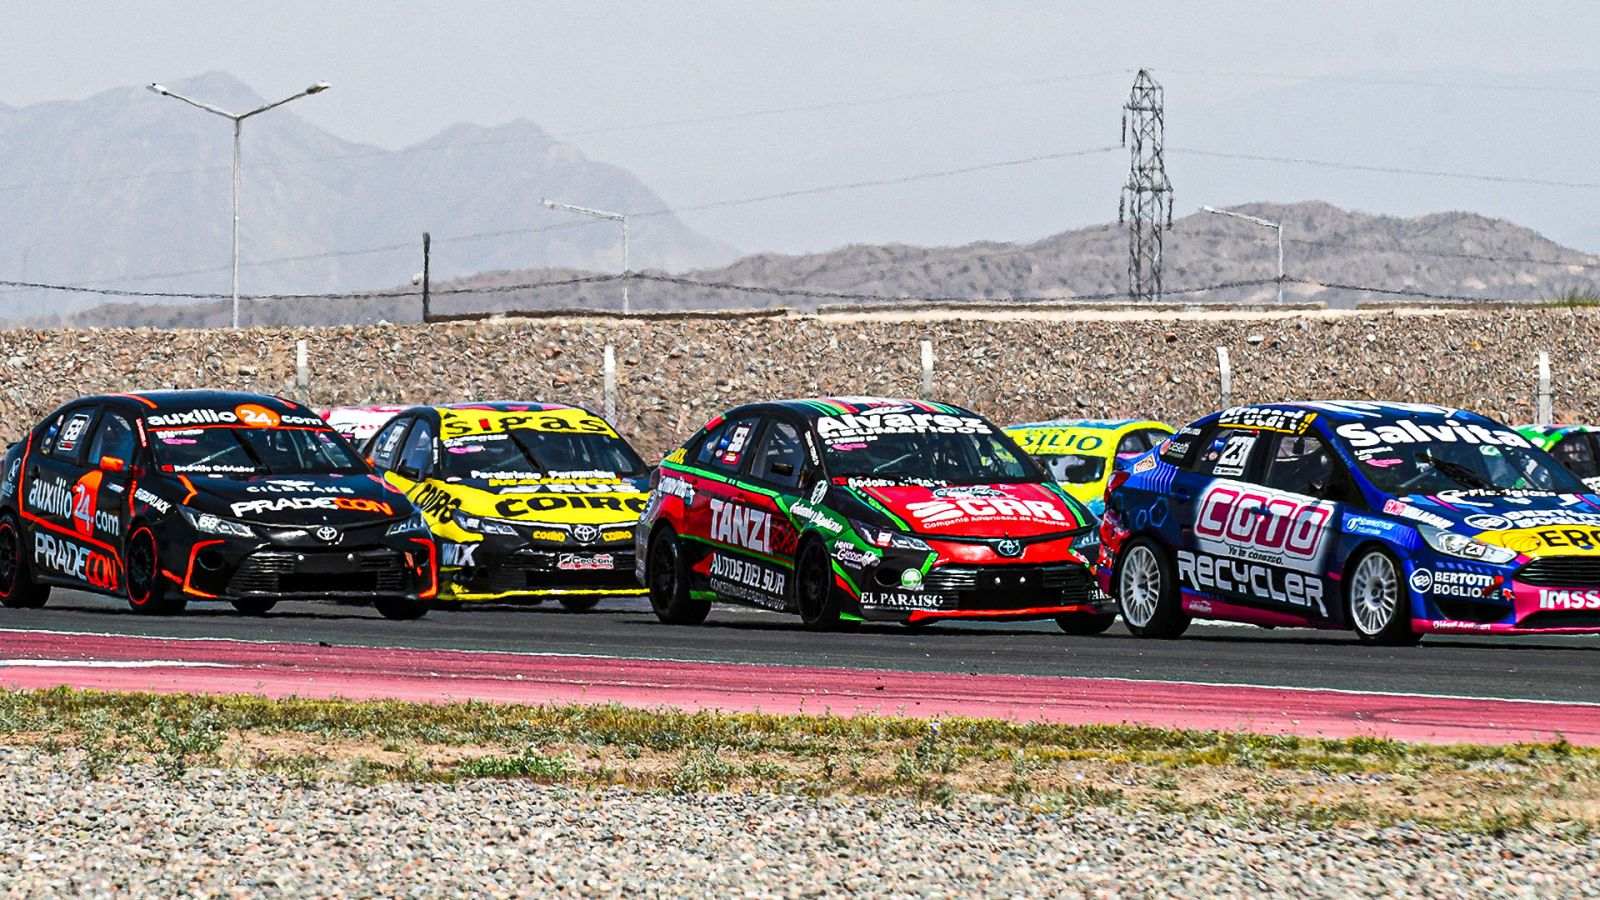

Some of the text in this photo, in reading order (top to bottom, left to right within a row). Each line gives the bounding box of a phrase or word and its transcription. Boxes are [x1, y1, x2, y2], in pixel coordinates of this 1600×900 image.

[817, 413, 986, 433] Alvarez
[230, 497, 395, 518] PRADECON
[710, 499, 773, 556] TANZI
[1196, 487, 1331, 555] COTO
[34, 532, 119, 591] PRADECON
[442, 543, 480, 567] WIX
[710, 552, 785, 595] AUTOS DEL SUR
[860, 592, 877, 604] EL
[1433, 583, 1500, 600] BOGLIOE
